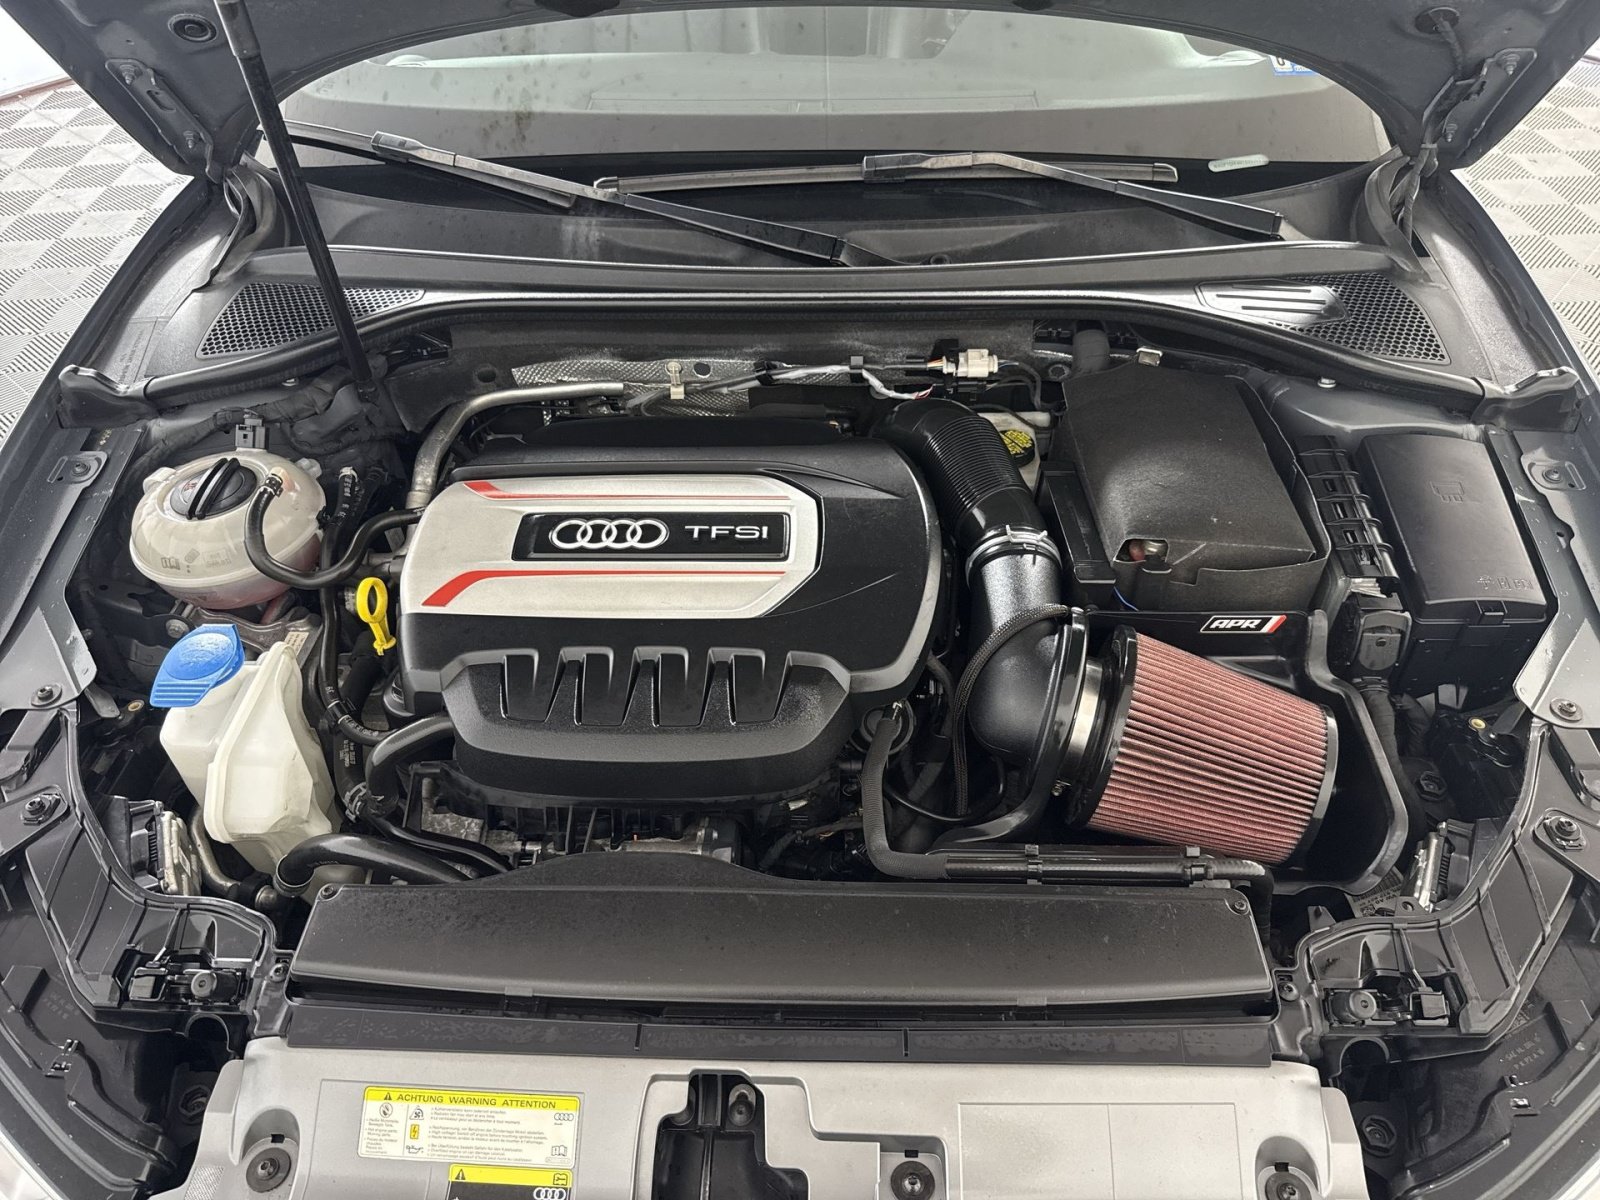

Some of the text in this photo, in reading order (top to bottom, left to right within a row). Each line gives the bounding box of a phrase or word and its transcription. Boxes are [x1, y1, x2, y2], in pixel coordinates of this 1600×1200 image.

[684, 525, 769, 539] TFSI
[1209, 619, 1262, 629] APR
[397, 1094, 556, 1109] ACHTUNG WARNING ATTENTION
